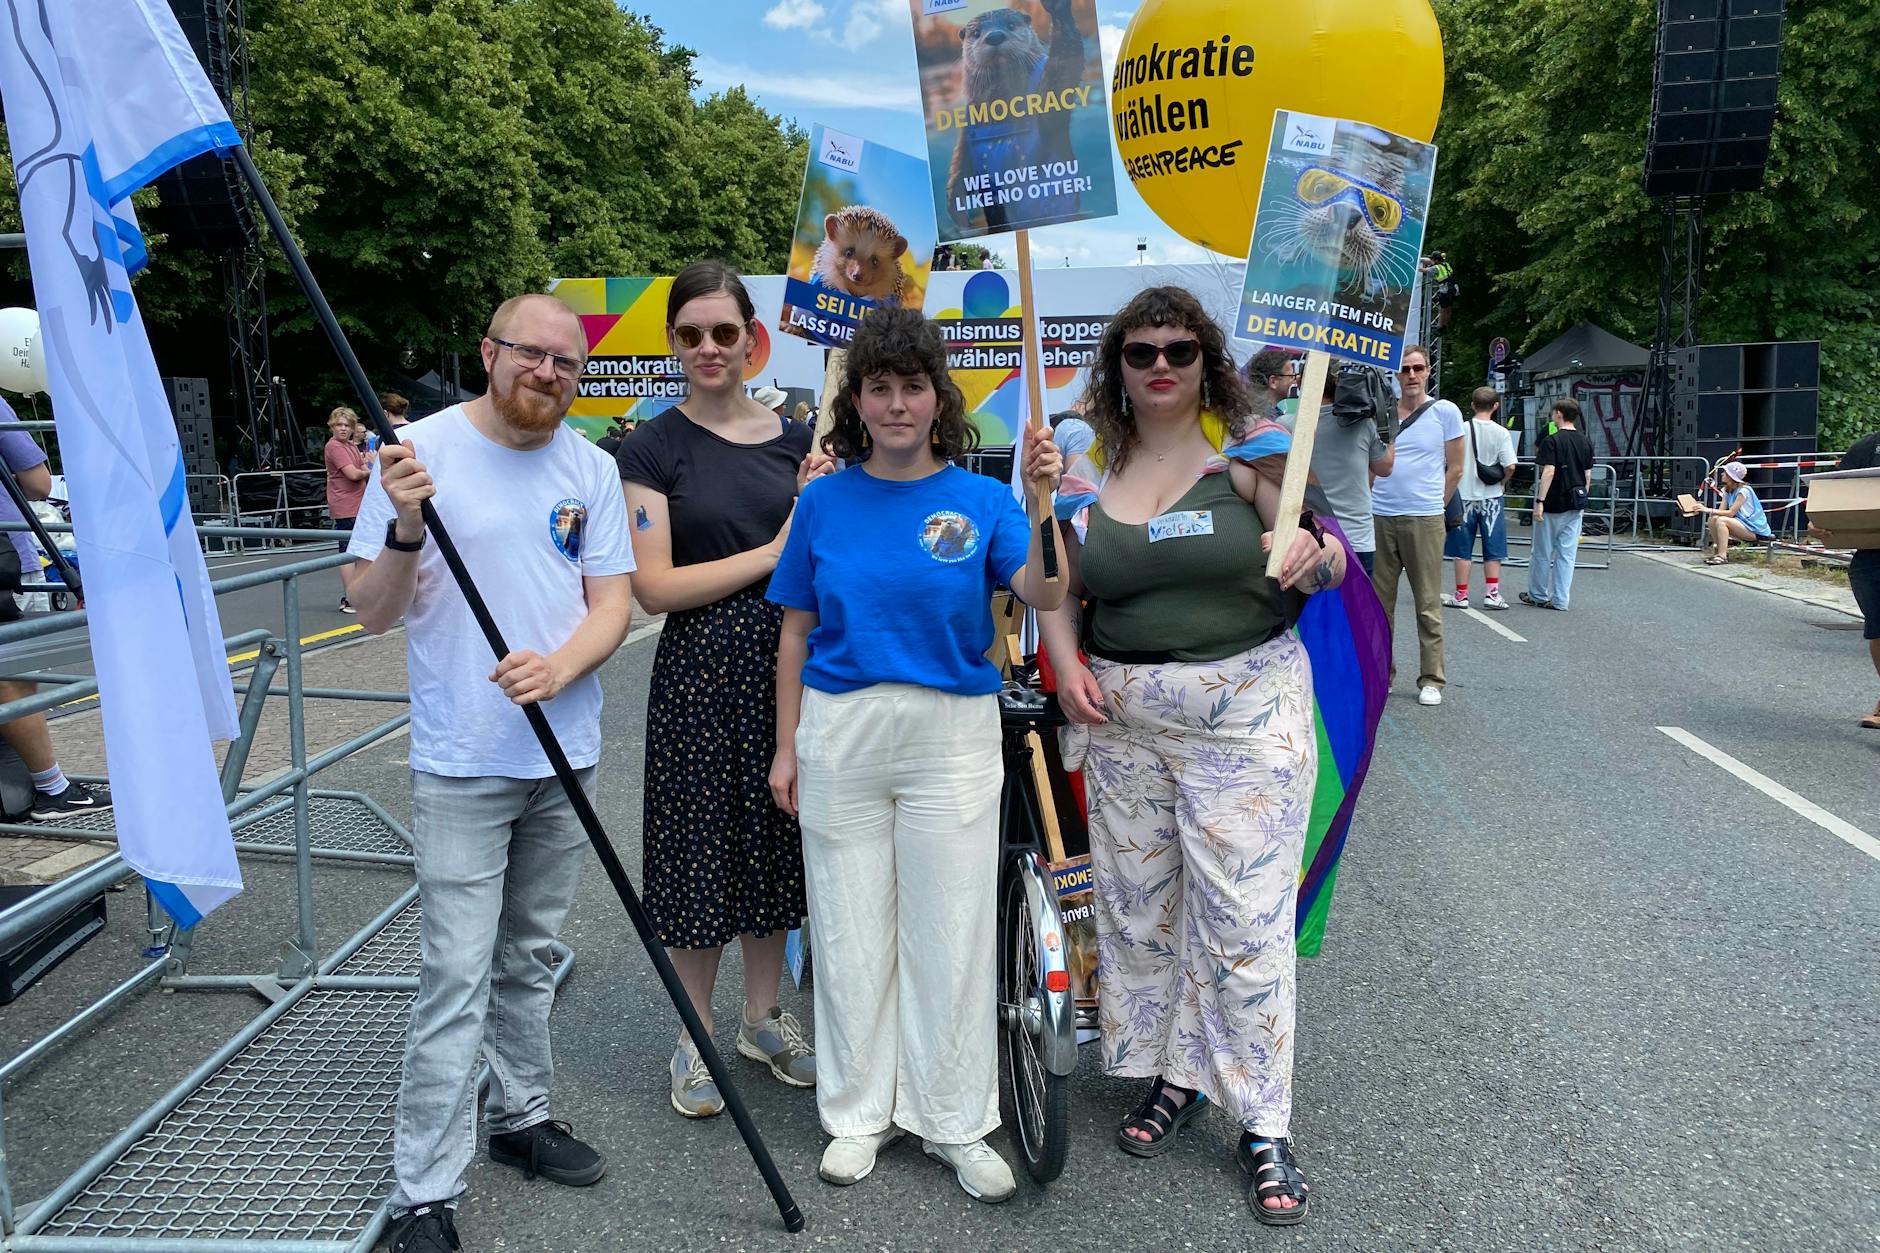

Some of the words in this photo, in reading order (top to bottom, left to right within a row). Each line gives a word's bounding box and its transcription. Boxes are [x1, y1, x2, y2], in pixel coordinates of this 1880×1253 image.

[1113, 34, 1255, 94] emokratie
[935, 85, 1091, 131] DEMOCRACY
[1116, 93, 1209, 142] wählen
[829, 154, 854, 167] NABU
[1295, 139, 1325, 150] NABU
[964, 174, 991, 192] WE
[994, 165, 1039, 187] LOVE
[1041, 159, 1079, 179] YOU
[955, 192, 994, 211] LIKE
[998, 187, 1024, 205] NO
[1027, 175, 1092, 197] OTTER!
[815, 293, 845, 315] SEI
[1252, 290, 1316, 312] LANGER
[1318, 300, 1361, 323] ATEM
[1363, 312, 1394, 332] FÜR
[788, 310, 827, 334] LASS
[829, 322, 856, 341] DIE
[940, 321, 1020, 340] mismus
[1247, 314, 1392, 361] DEMOKRATIE
[583, 356, 685, 375] emokrati
[946, 348, 1021, 367] wählen
